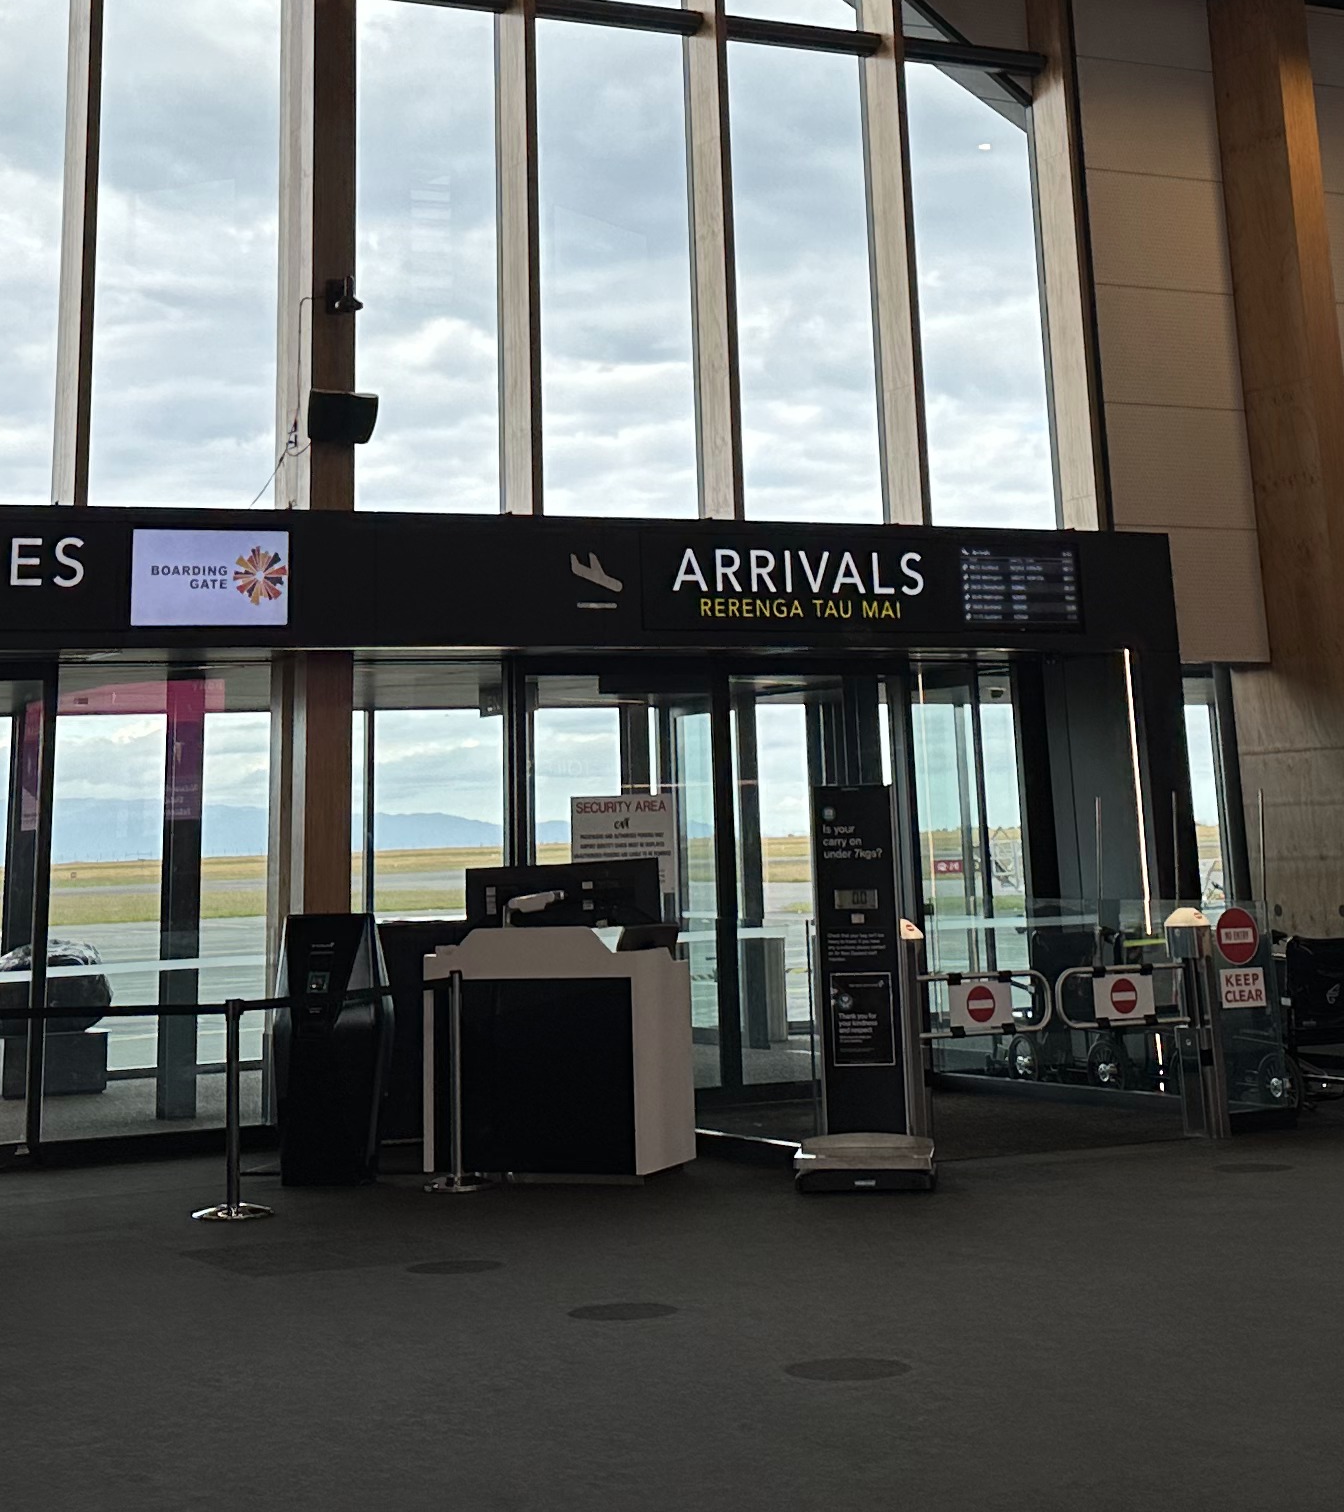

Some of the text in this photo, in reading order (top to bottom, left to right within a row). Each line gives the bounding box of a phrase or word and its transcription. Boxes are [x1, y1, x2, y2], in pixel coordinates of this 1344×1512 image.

[151, 565, 228, 576] BOARDING
[673, 548, 924, 596] ARRIVALS
[190, 579, 228, 589] GATE
[700, 598, 901, 619] RERENGA TAU MAI
[576, 800, 666, 814] SECURITY AREA
[822, 825, 855, 836] Is your
[822, 838, 862, 848] carry on
[823, 848, 883, 860] under 7kgs?
[1225, 930, 1249, 941] NO ENTRY
[1225, 973, 1259, 987] KEEP
[1225, 989, 1263, 1003] CLEAR
